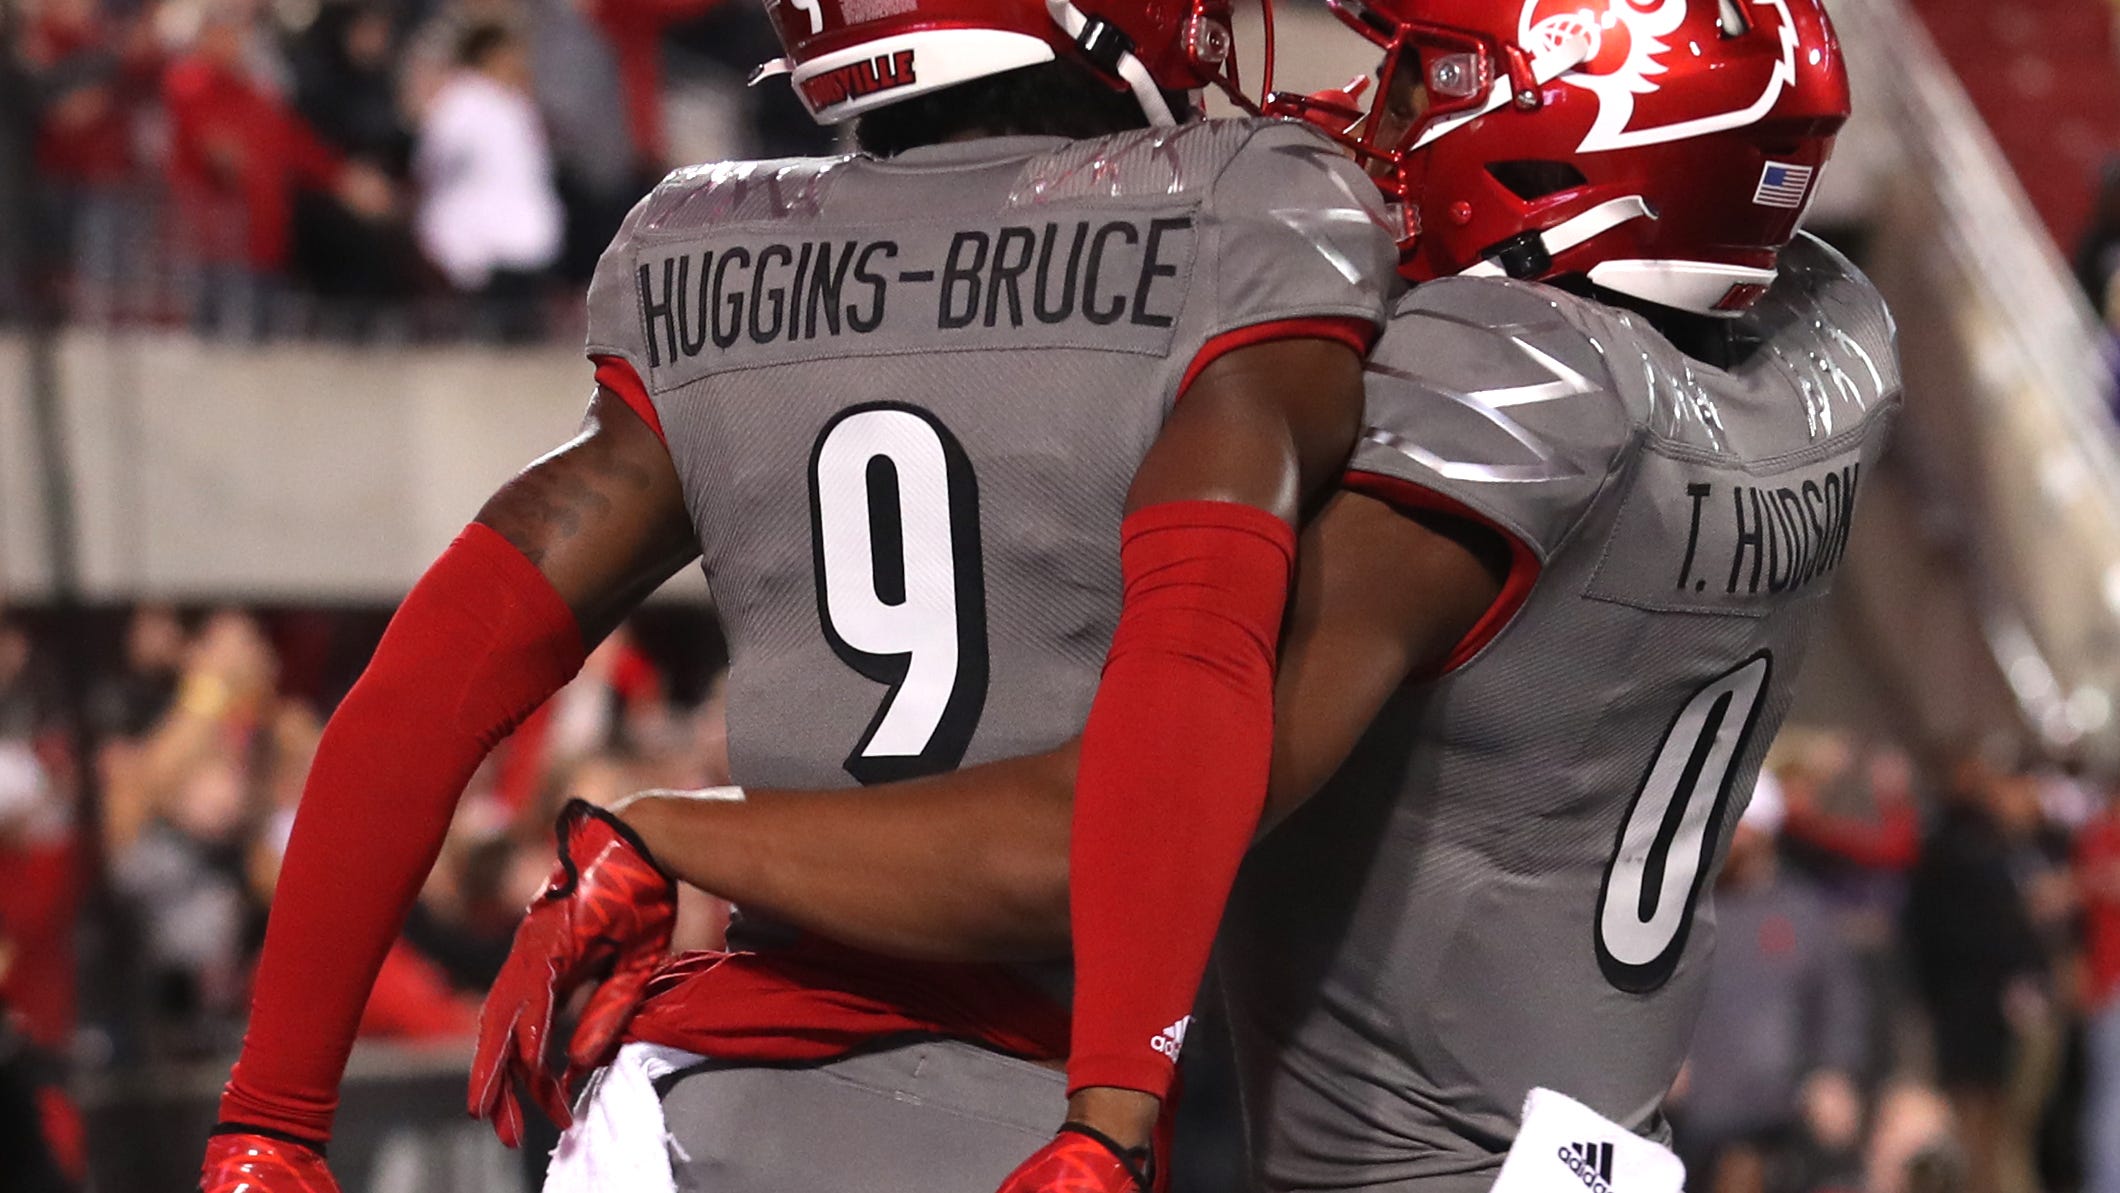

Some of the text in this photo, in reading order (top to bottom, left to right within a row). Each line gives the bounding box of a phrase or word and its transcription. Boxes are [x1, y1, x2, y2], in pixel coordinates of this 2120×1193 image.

[639, 216, 1192, 368] HUGGINS-BRUCE
[808, 400, 990, 786] 9
[1677, 463, 1860, 593] T. HUDSON
[1594, 647, 1772, 993] 0
[1558, 1146, 1614, 1193] adida
